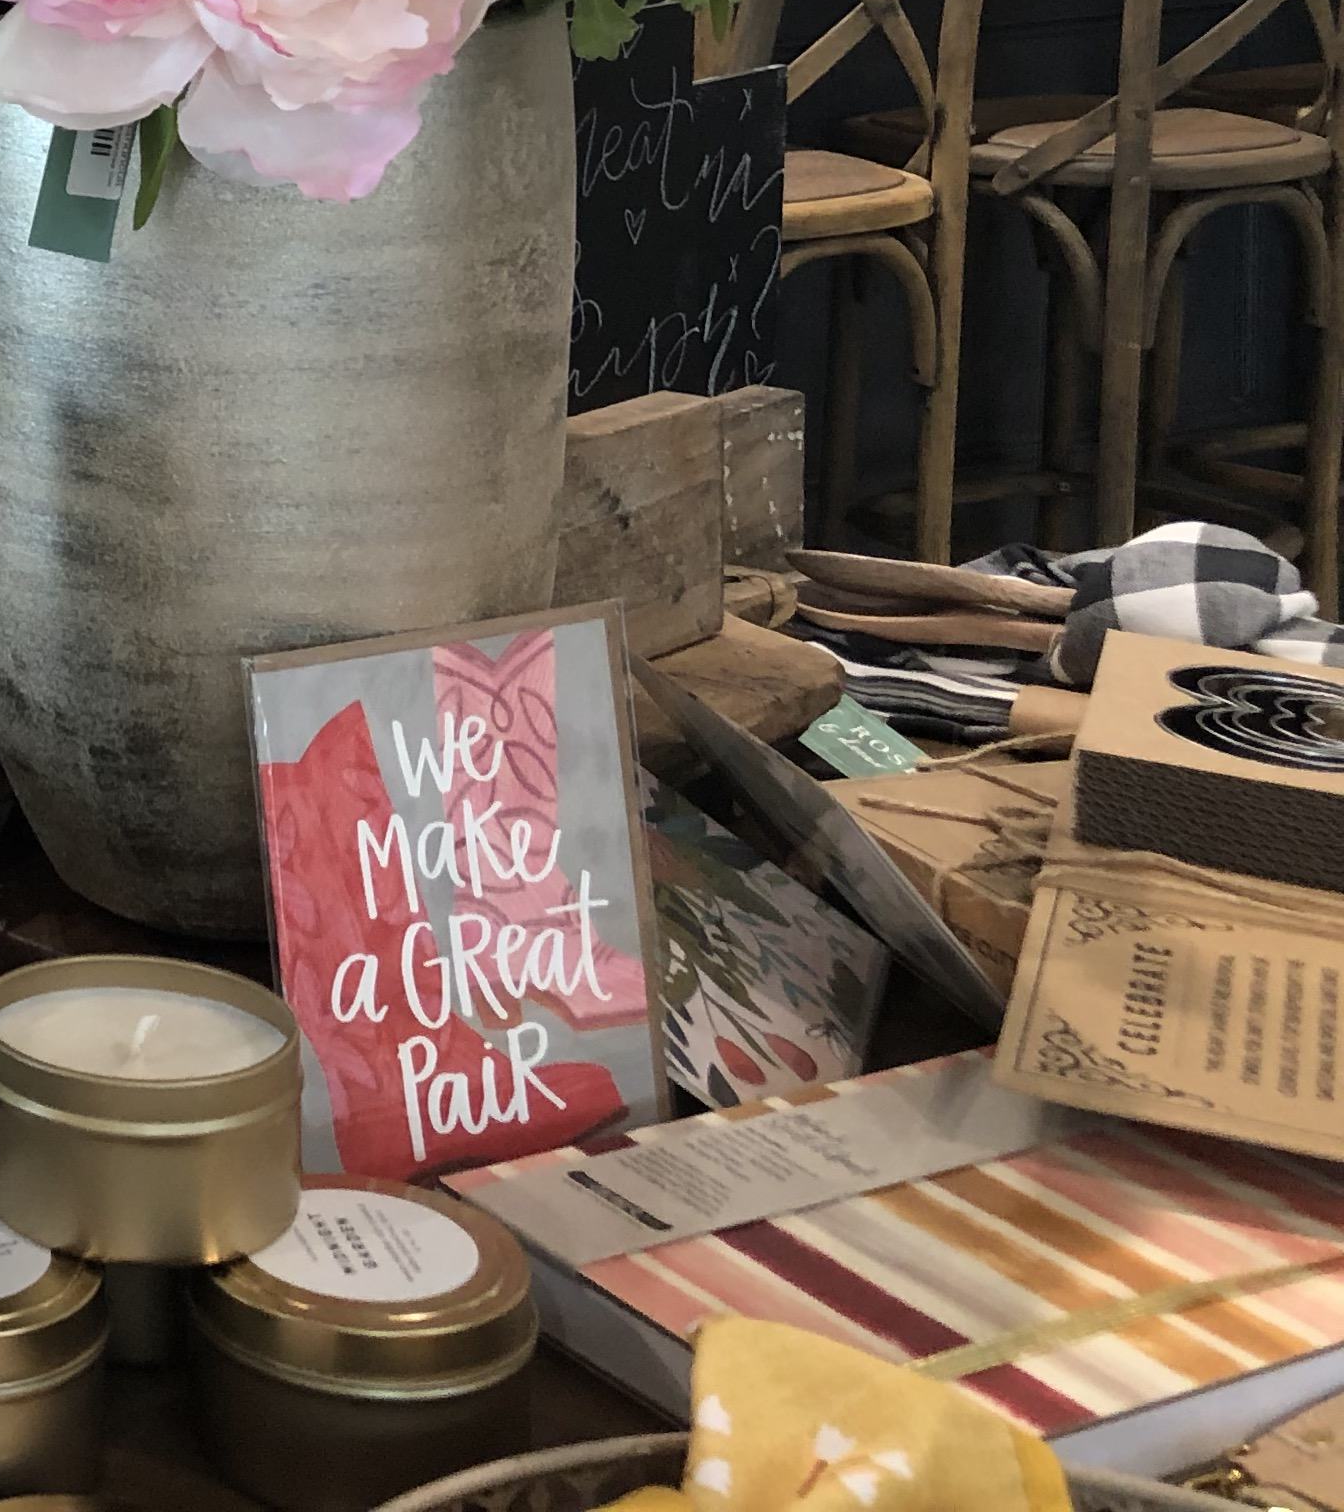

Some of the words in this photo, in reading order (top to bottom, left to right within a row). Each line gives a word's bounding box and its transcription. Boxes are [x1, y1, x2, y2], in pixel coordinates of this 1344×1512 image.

[392, 711, 505, 798] We
[849, 725, 917, 774] ROS
[330, 952, 388, 1024] a
[1117, 942, 1174, 1056] CELEBRATE
